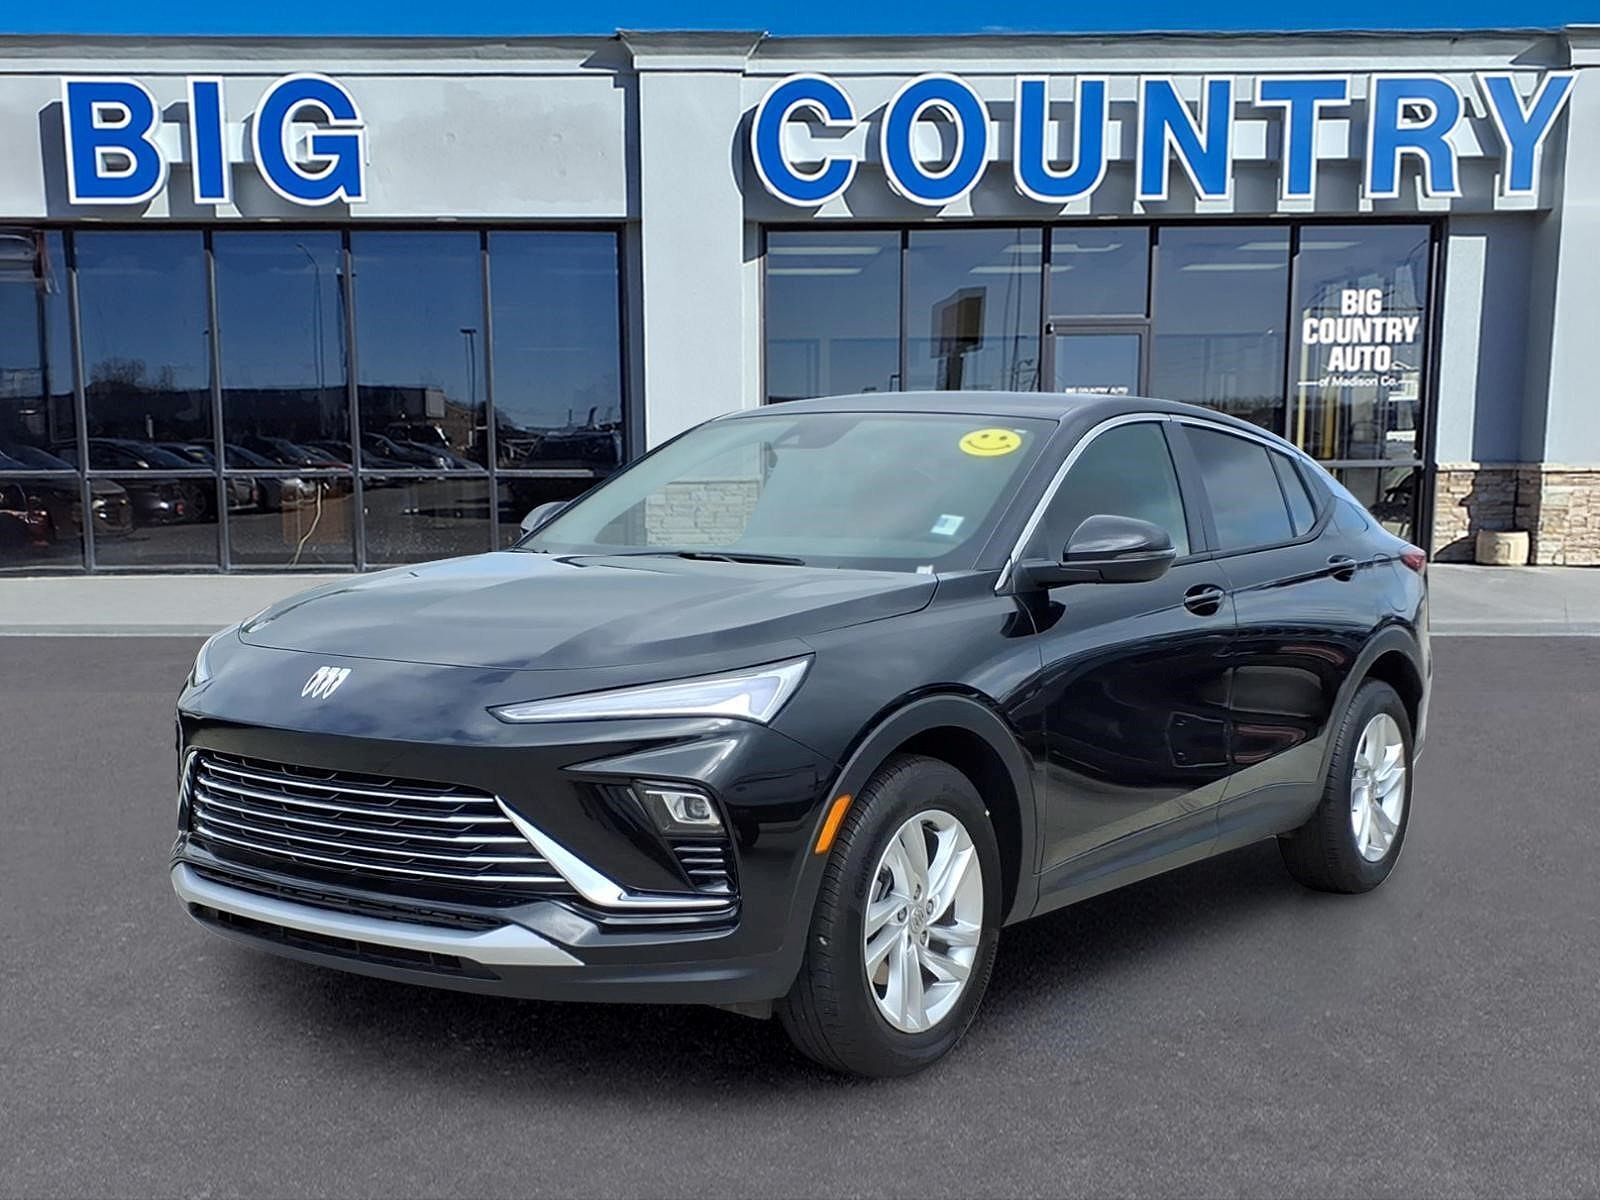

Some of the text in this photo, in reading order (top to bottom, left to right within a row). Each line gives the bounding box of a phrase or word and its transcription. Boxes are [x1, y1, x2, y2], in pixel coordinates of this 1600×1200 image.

[61, 71, 1575, 207] BIG COUNTRY
[1341, 289, 1383, 316] BIG
[1303, 317, 1419, 344] COUNTRY
[1328, 345, 1391, 372] AUTO
[1331, 376, 1378, 387] Madison
